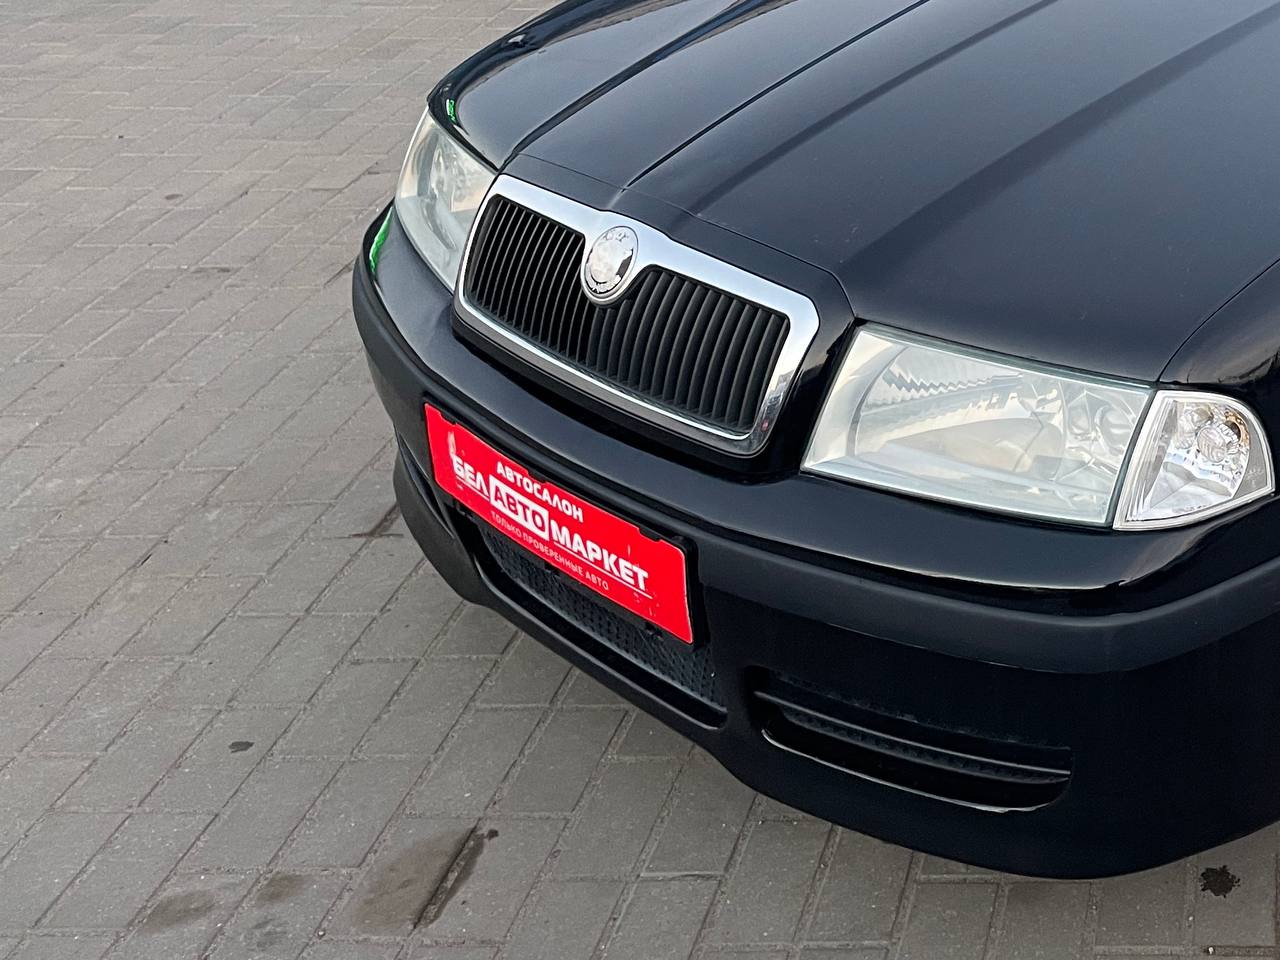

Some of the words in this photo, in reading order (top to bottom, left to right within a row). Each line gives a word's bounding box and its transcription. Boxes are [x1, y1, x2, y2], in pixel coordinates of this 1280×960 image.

[452, 453, 490, 497] БЕЛ
[494, 483, 546, 534] АВТО
[550, 519, 649, 591] МАРКЕТ
[496, 460, 584, 523] АВТОСАЛОН
[585, 571, 609, 591] АВТО
